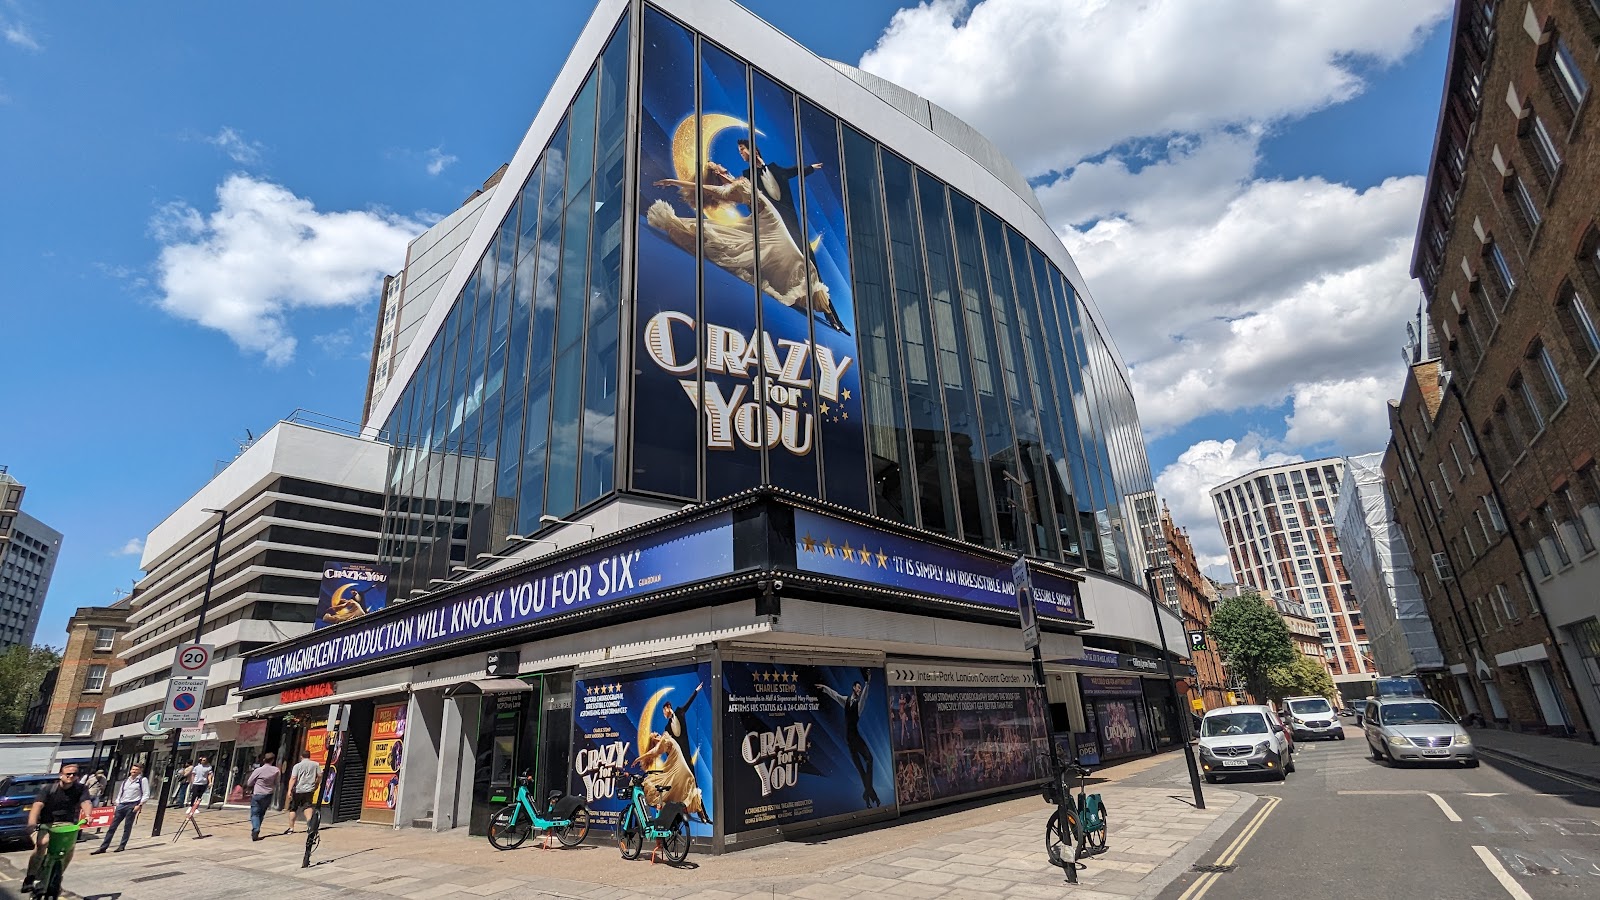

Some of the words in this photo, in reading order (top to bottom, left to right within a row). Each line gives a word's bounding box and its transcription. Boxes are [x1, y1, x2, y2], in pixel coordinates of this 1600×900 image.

[644, 310, 853, 402] CRAZY
[752, 375, 802, 408] for
[678, 379, 813, 456] YOU
[324, 568, 360, 581] CRAZY
[364, 571, 387, 583] YOU
[906, 559, 915, 576] IS
[915, 561, 943, 582] SIMPLY
[945, 568, 957, 585] AN
[957, 570, 1001, 593] IRRESISTIBLE
[1001, 581, 1016, 596] AND
[283, 637, 343, 677] MAGNIFICENT
[340, 615, 414, 662] PRODUCTION
[416, 607, 447, 642] WILL
[450, 588, 506, 634] KNOCK
[509, 576, 546, 619] YOU
[551, 564, 592, 609] FOR
[1192, 634, 1203, 645] P
[183, 653, 204, 664] 20
[488, 655, 499, 663] Cash
[956, 672, 979, 683] London
[980, 673, 1000, 683] Covent
[1000, 674, 1021, 683] Garden
[728, 703, 750, 713] AFFIRMS
[750, 703, 759, 712] HIS
[759, 703, 777, 712] STATUS
[787, 703, 808, 711] 24-CARAT
[742, 721, 812, 764] CRAZY
[1079, 746, 1097, 756] OPEN
[575, 740, 631, 775] CRAZY
[777, 750, 794, 765] for
[599, 766, 613, 779] for
[754, 758, 798, 797] YOU
[582, 771, 616, 803] YOU
